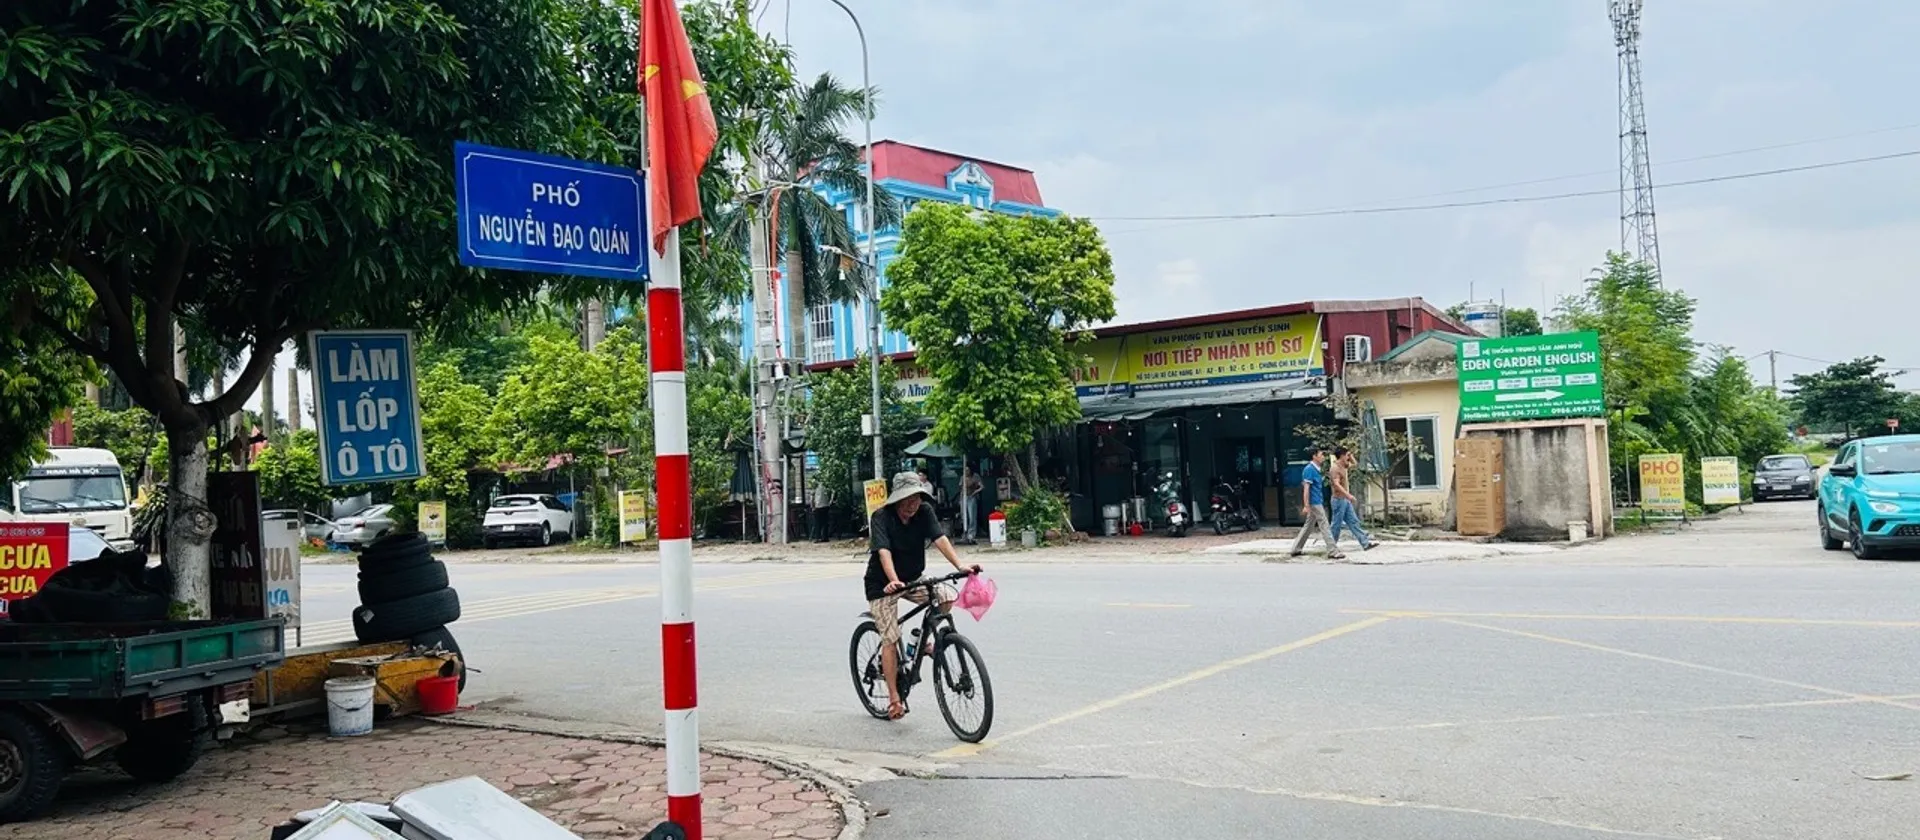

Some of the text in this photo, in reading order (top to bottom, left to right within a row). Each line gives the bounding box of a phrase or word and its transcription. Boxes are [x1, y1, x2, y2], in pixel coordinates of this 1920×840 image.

[532, 180, 580, 206] PHỐ
[479, 208, 630, 255] NGUYỄN ĐẠO QUÁN
[1267, 323, 1290, 333] SINH
[328, 341, 400, 383] LÀM
[1143, 351, 1168, 368] NƠI
[1171, 343, 1203, 364] TIẾP
[1207, 340, 1250, 362] NHẬN
[1281, 336, 1302, 354] SƠ
[1462, 352, 1595, 371] EDEN GARDEN ENGLISH
[337, 386, 399, 432] LỐP
[337, 438, 408, 477] Ô TÔ
